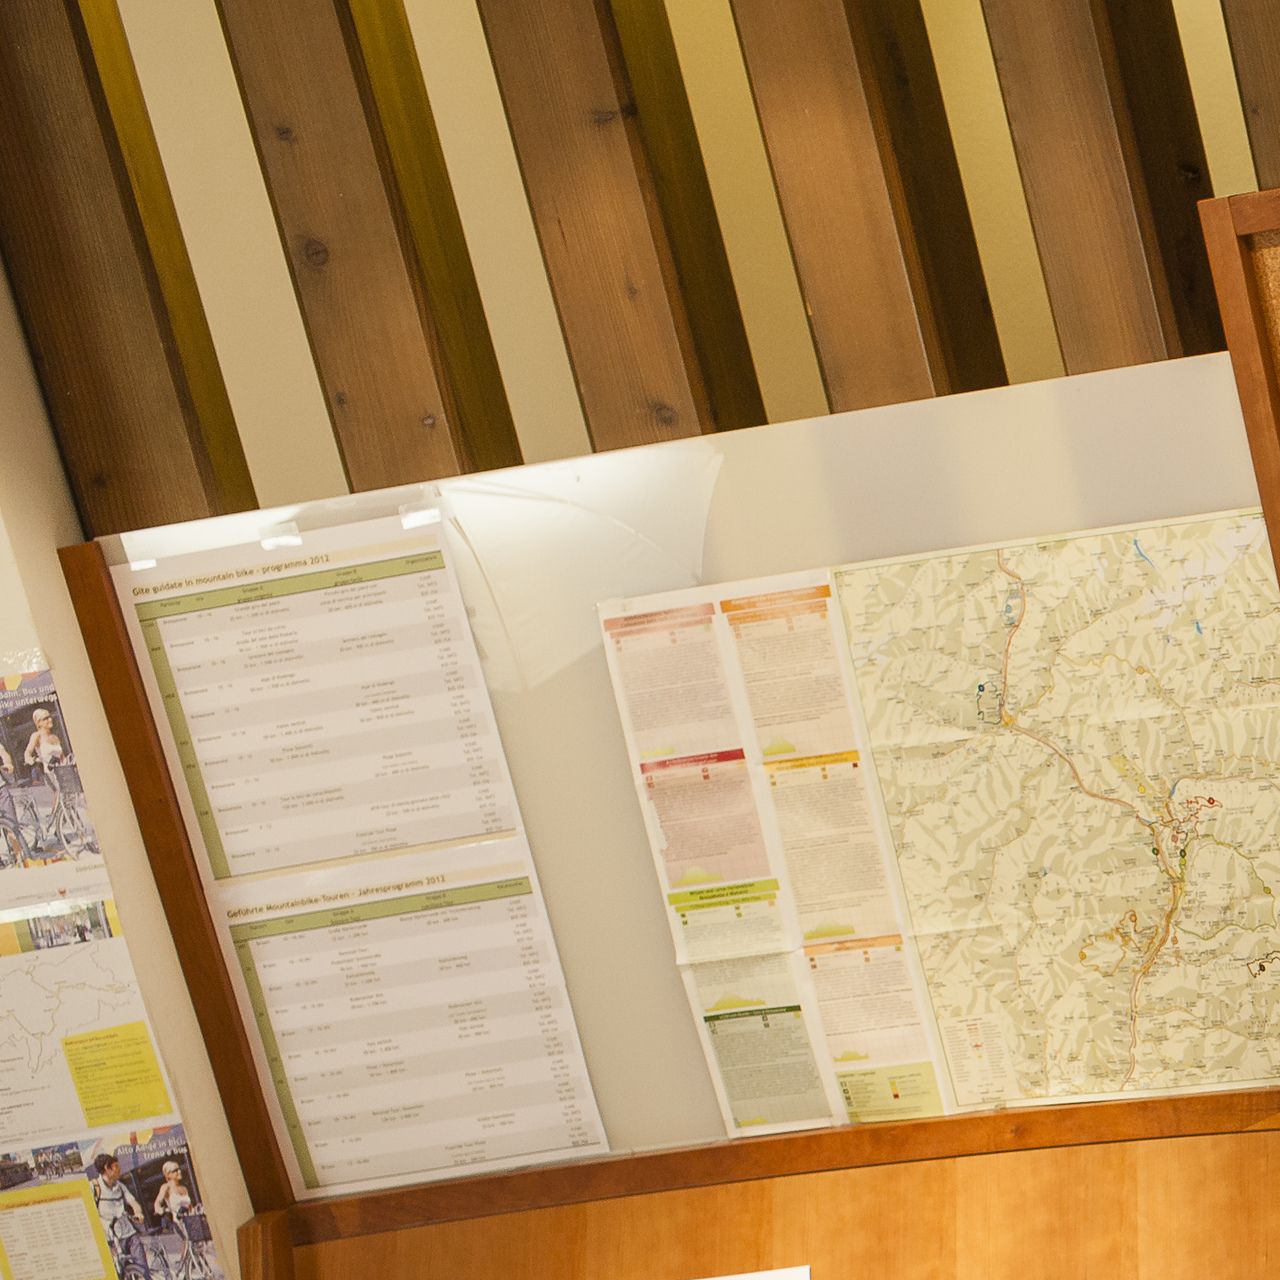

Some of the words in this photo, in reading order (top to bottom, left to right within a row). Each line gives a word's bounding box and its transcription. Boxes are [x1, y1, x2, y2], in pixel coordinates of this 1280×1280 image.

[132, 585, 150, 597] Gite
[152, 577, 183, 595] guidate
[185, 577, 192, 588] in
[194, 569, 233, 586] mountain
[235, 566, 253, 581] bike
[262, 559, 308, 578] programma
[309, 553, 331, 568] 2012
[226, 904, 264, 919] Geführte
[358, 879, 424, 900] Jahresprogramm
[425, 873, 446, 888] 2012
